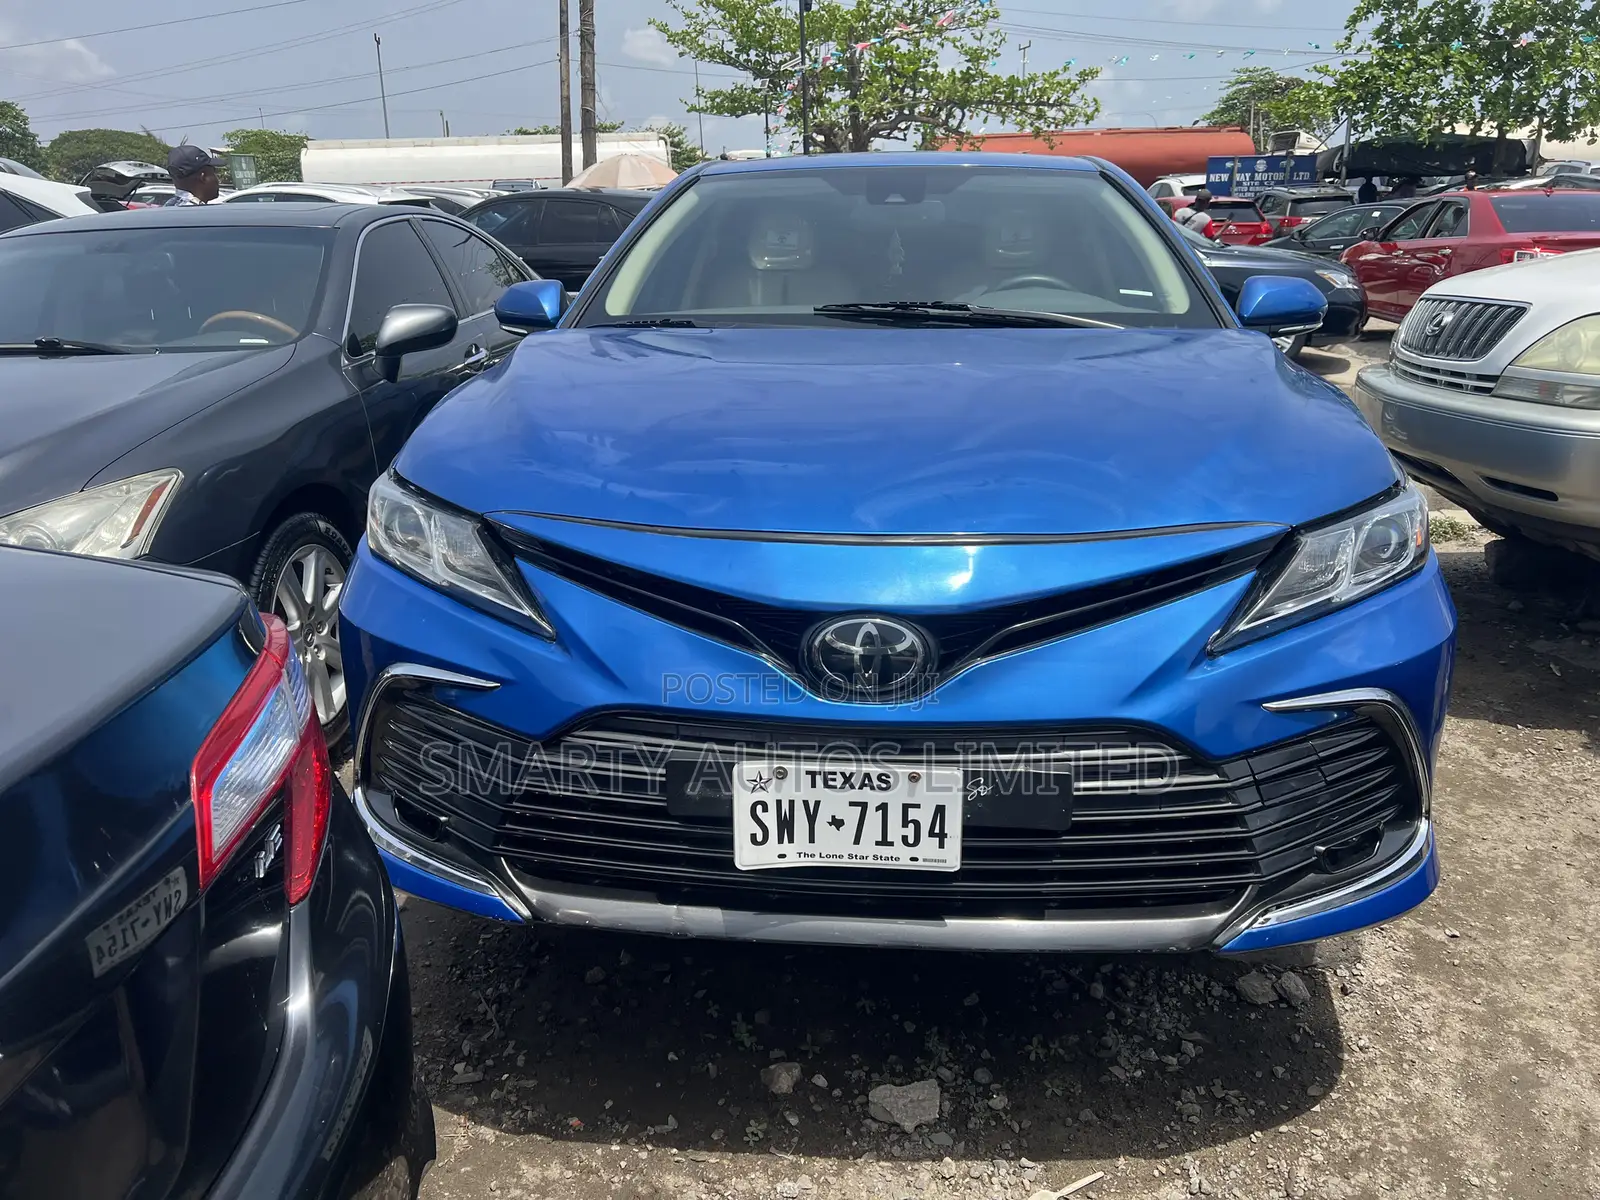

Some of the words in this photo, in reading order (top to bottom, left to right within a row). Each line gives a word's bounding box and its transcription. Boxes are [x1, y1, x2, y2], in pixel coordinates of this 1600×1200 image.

[1209, 173, 1230, 182] NEW
[805, 770, 892, 791] TEXAS
[749, 799, 821, 847] SWY
[848, 801, 948, 849] 7154
[796, 851, 816, 859] The
[819, 852, 845, 860] Lone
[847, 852, 871, 862] Star
[872, 853, 901, 862] State
